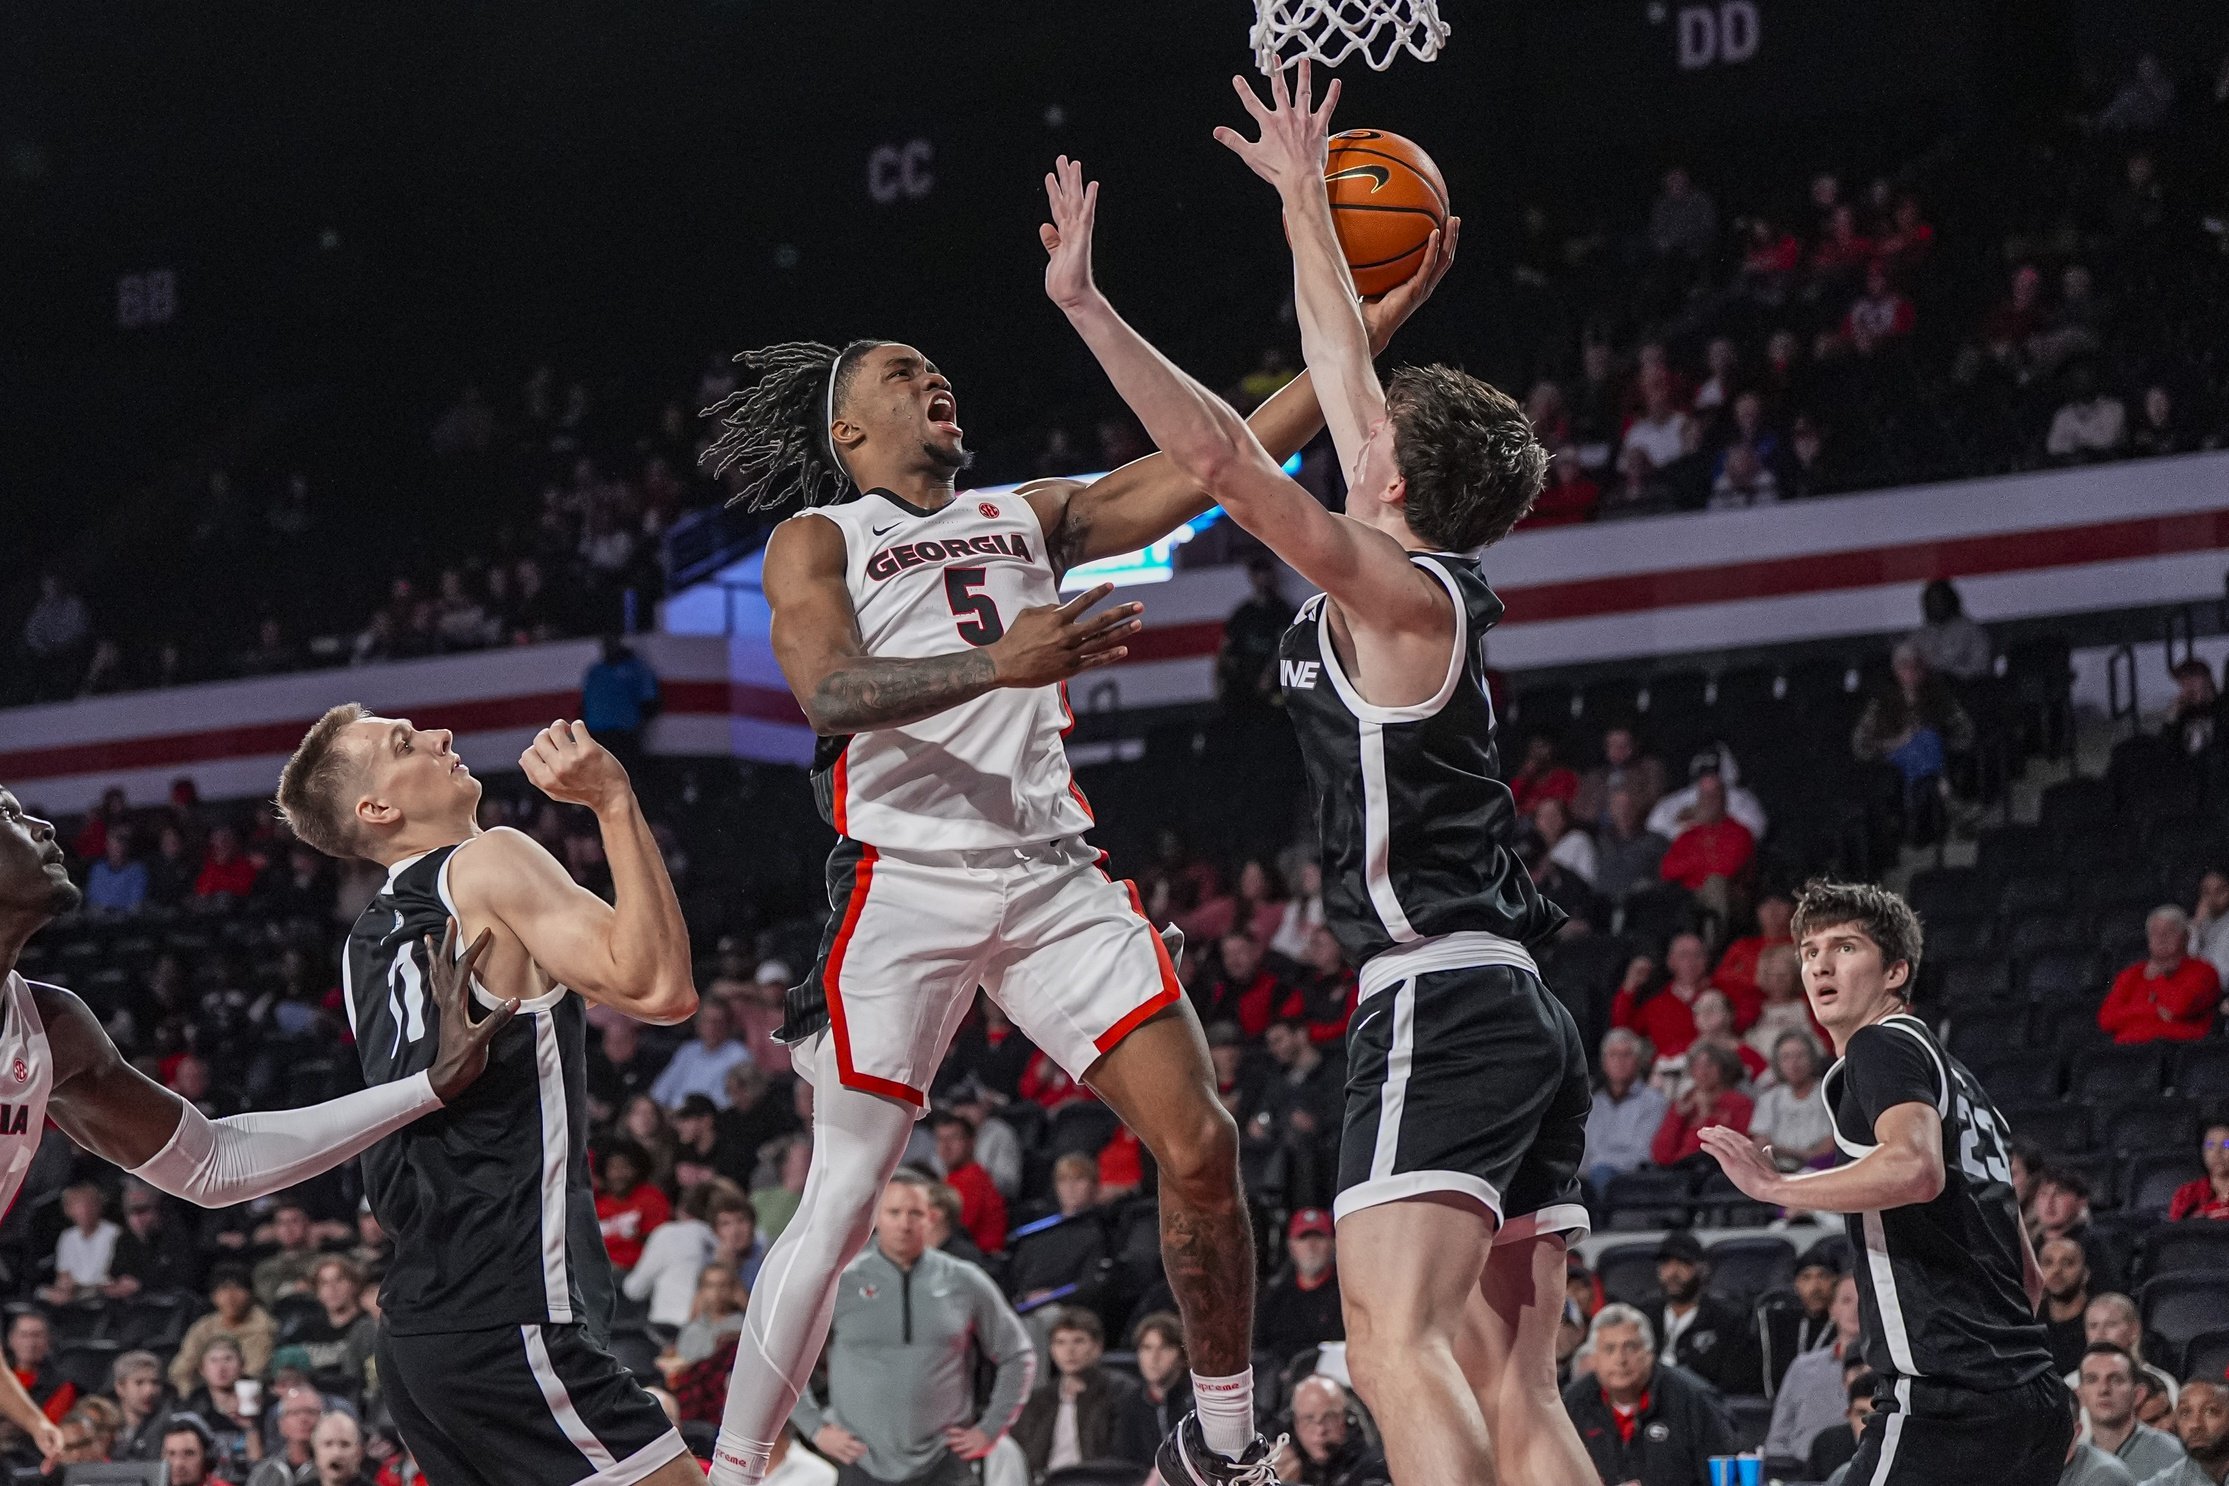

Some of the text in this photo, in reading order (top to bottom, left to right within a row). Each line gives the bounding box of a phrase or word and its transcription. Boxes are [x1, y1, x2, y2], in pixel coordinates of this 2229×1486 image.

[1678, 0, 1760, 69] DD
[868, 139, 933, 202] CC
[979, 503, 999, 518] SEC
[867, 533, 1035, 581] GEORGIA
[944, 567, 1004, 647] 5
